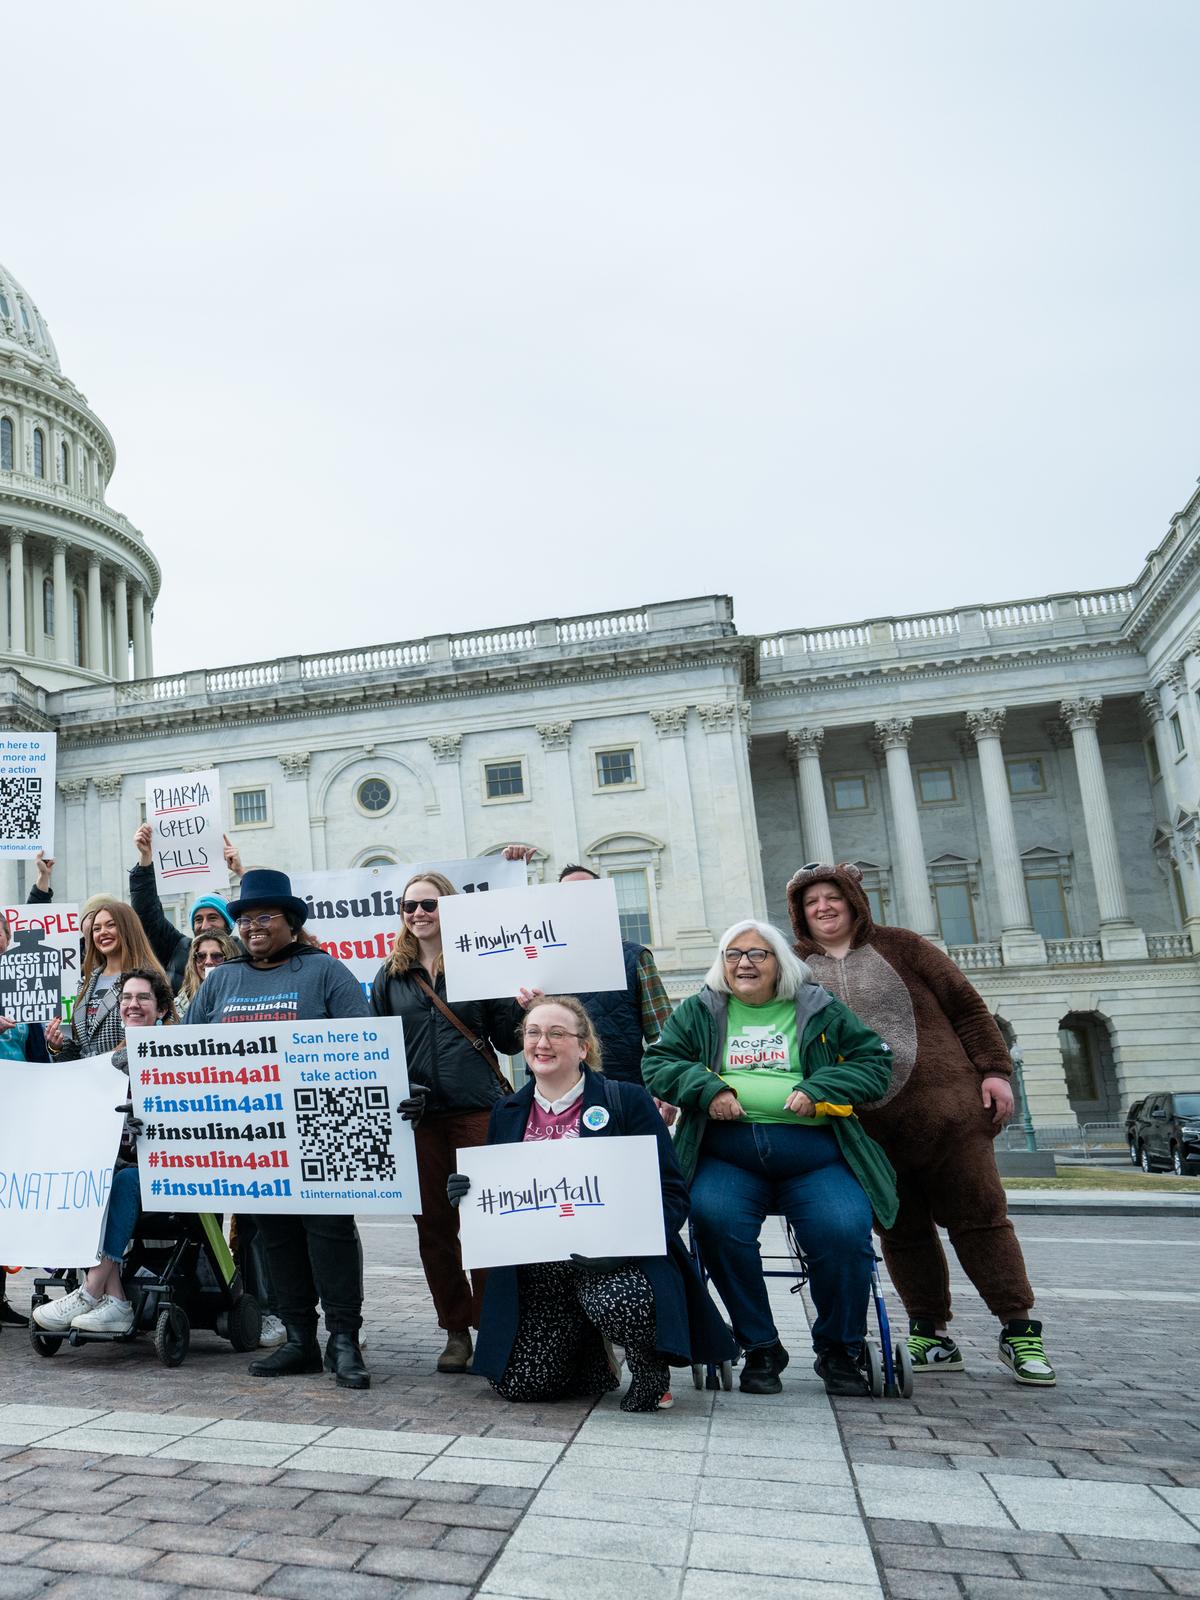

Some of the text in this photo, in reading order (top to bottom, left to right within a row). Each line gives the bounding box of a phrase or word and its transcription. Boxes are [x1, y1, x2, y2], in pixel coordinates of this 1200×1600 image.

[7, 740, 27, 749] here
[30, 741, 39, 749] to
[29, 753, 46, 761] and
[8, 766, 36, 774] action
[153, 782, 210, 810] PHARMA
[160, 816, 206, 838] GREED
[159, 846, 208, 870] KILLS
[5, 909, 80, 935] PEOPLE
[455, 920, 556, 952] #insulin4all
[0, 952, 40, 966] ACCESS
[42, 951, 58, 962] TO
[0, 962, 59, 980] INSULIN
[16, 978, 44, 991] IS A
[2, 989, 58, 1007] HUMAN
[223, 1001, 298, 1013] #insulin4all
[227, 992, 298, 1004] #insulin4all
[4, 1004, 57, 1022] RIGHT
[222, 1012, 297, 1023] #insulin4all
[292, 1030, 378, 1045] Scan here to
[137, 1036, 278, 1058] #insulin4all
[285, 1048, 390, 1064] learn more and
[730, 1052, 785, 1064] INSULIN
[140, 1064, 280, 1086] #insulin4all
[300, 1068, 377, 1082] take action
[143, 1093, 283, 1114] #insulin4all
[146, 1121, 286, 1142] #insulin4all
[148, 1150, 289, 1170] #insulin4all
[151, 1178, 292, 1199] #insulin4all
[300, 1188, 402, 1200] t1international.com
[477, 1175, 602, 1214] #insulin4all
